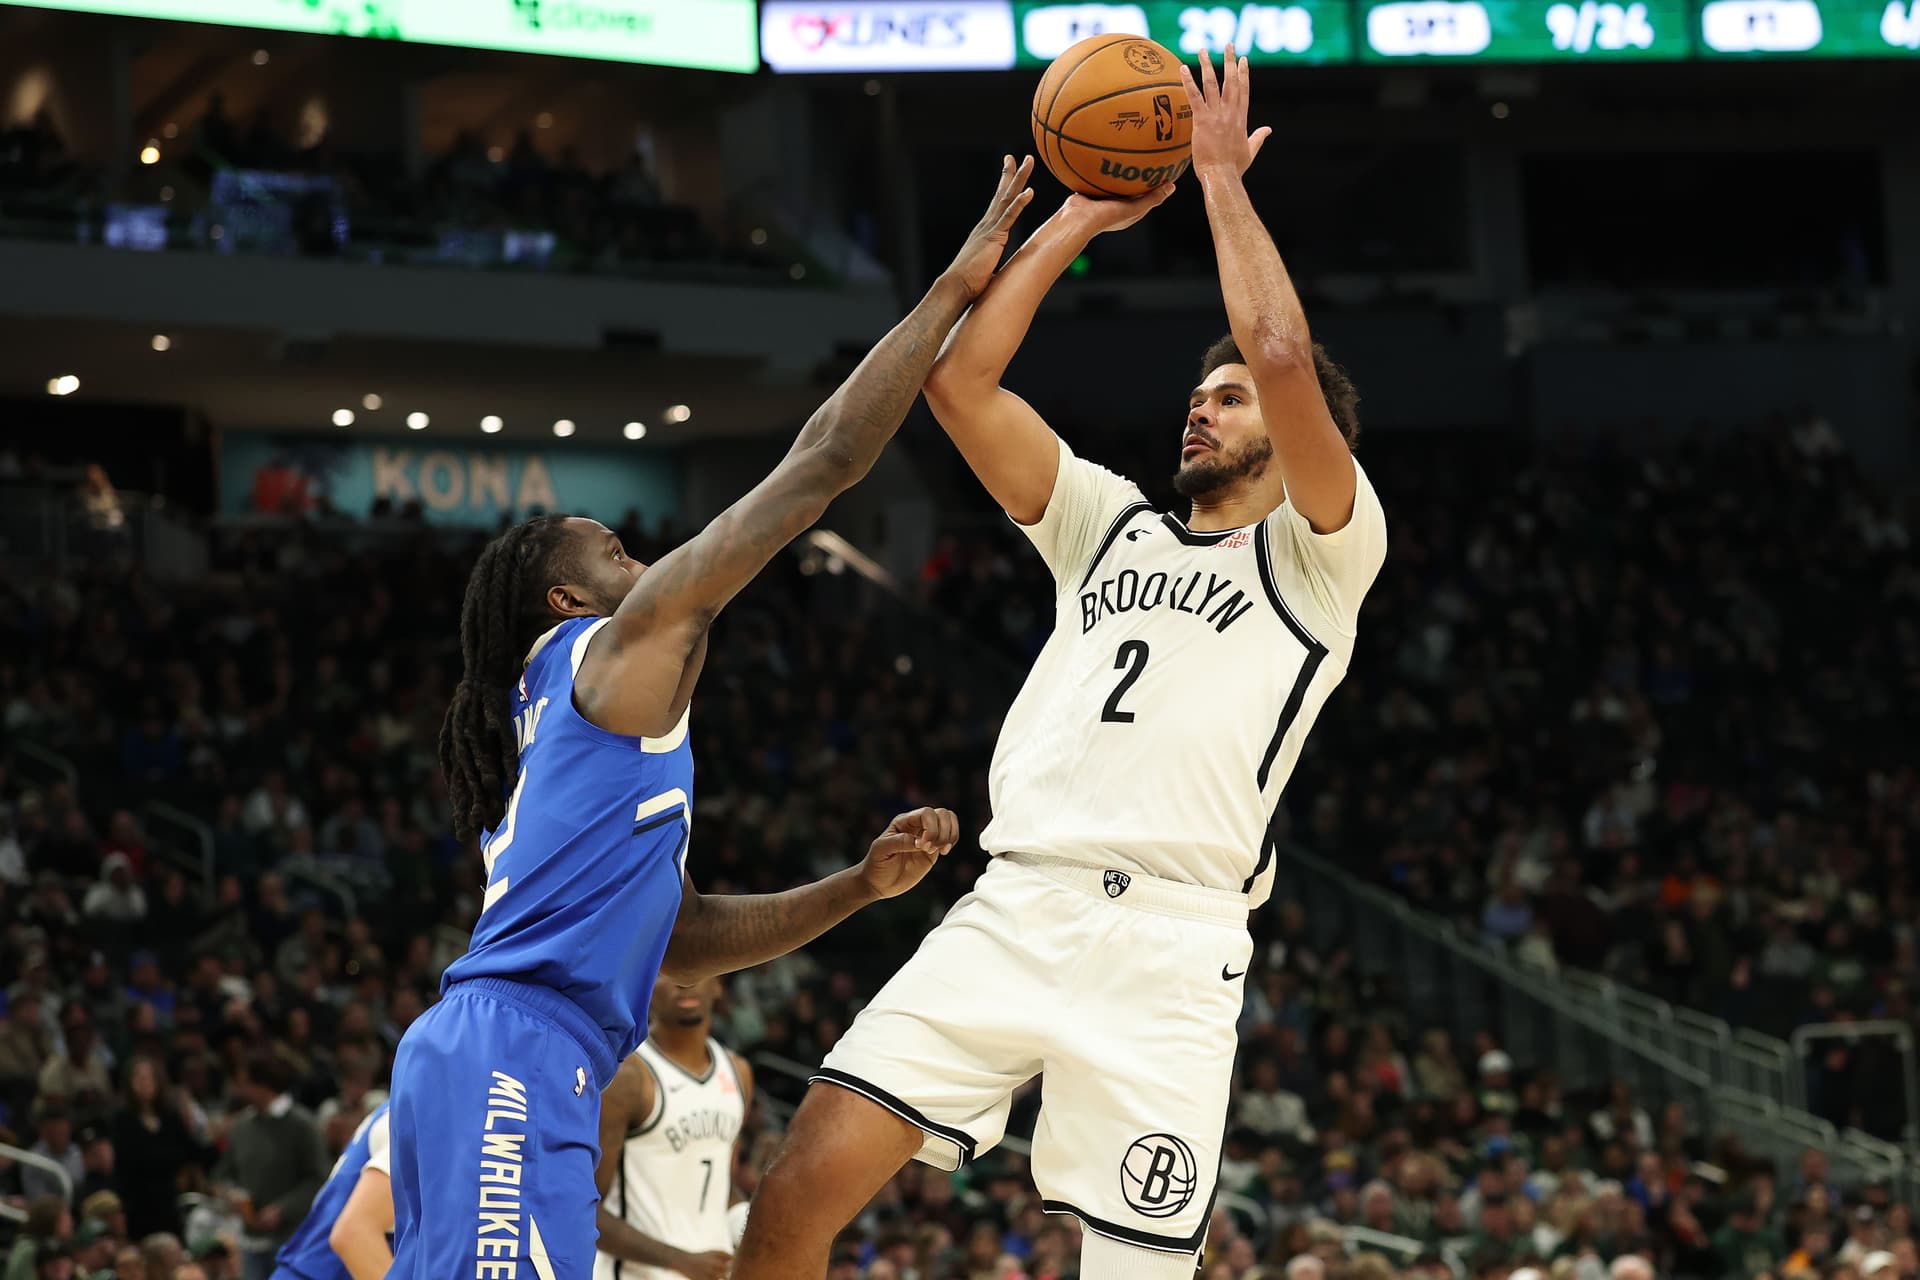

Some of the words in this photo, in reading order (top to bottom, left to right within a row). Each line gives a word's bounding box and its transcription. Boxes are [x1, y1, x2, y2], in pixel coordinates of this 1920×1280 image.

[373, 447, 557, 511] KONA
[1100, 639, 1150, 724] 2
[1104, 871, 1129, 887] NETS
[475, 1070, 528, 1280] MILWAUKEE
[700, 1159, 712, 1213] 7
[1140, 1144, 1176, 1205] B
